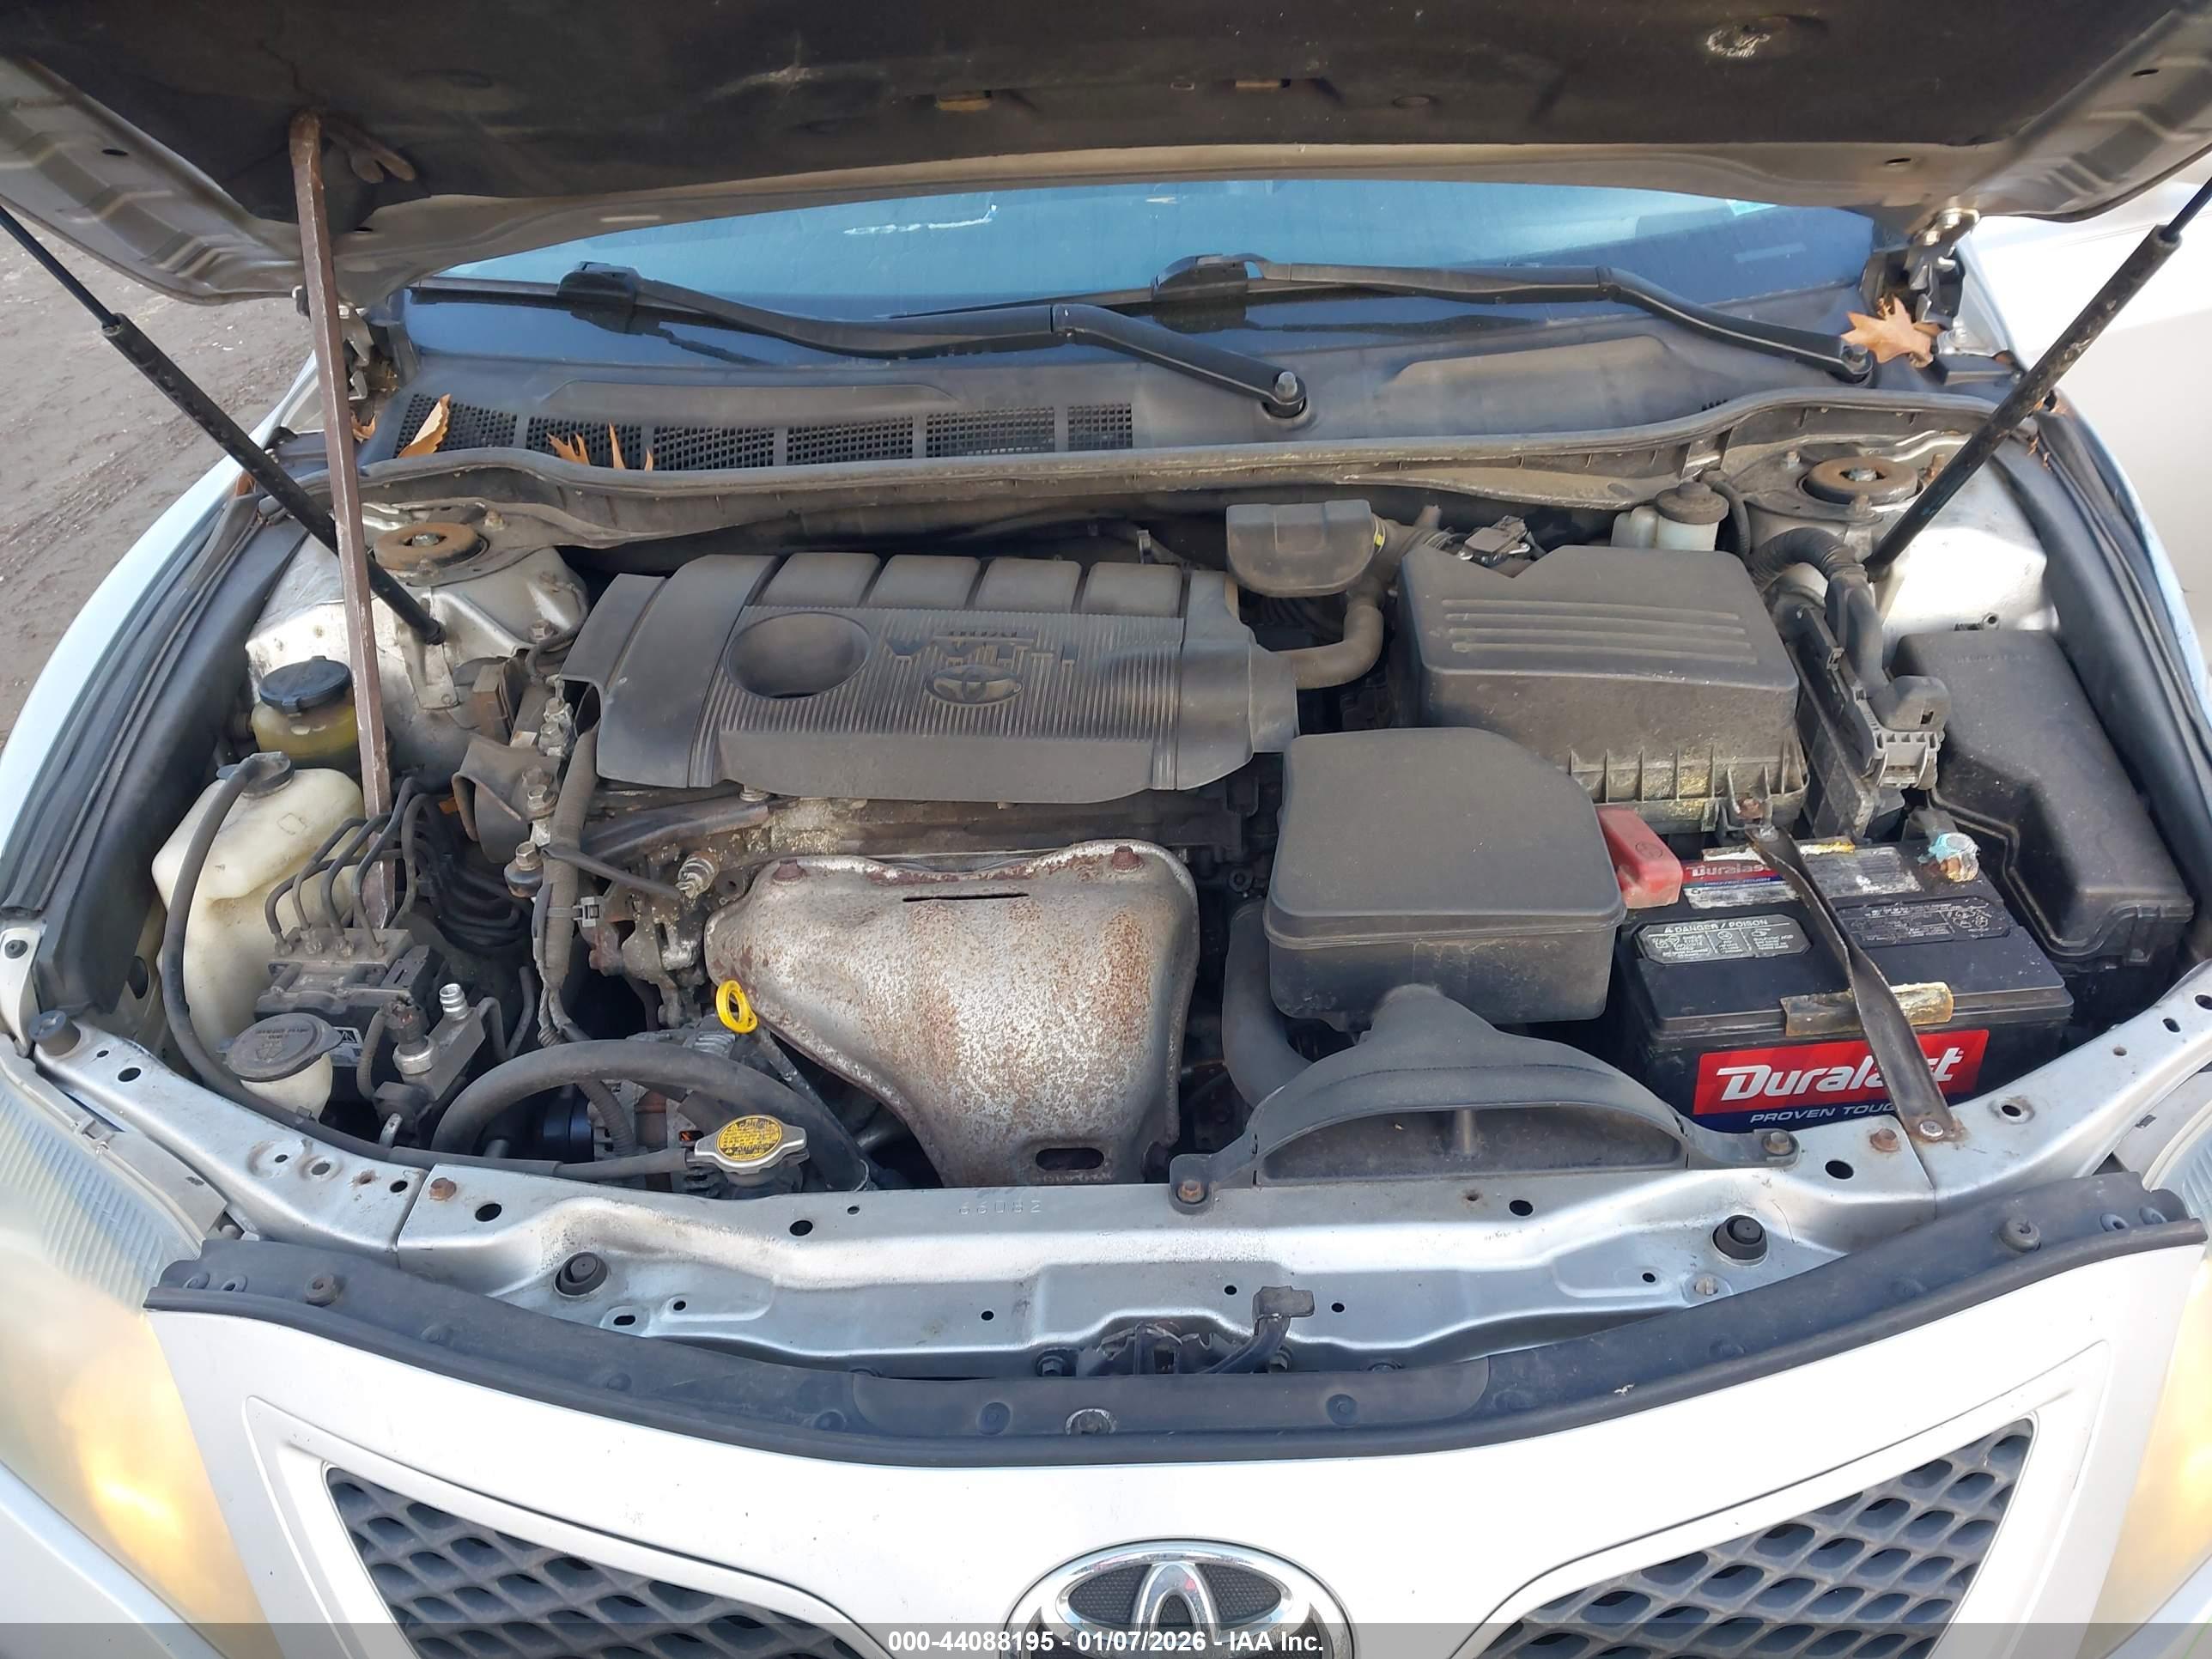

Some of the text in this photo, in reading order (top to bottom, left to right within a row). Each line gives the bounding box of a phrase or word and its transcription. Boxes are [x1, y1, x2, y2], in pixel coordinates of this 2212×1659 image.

[1675, 923, 1719, 933] DANGER
[1729, 919, 1768, 928] POISON
[1717, 1047, 1960, 1102] Duralt
[1750, 1103, 1895, 1123] PROVEN TOUG
